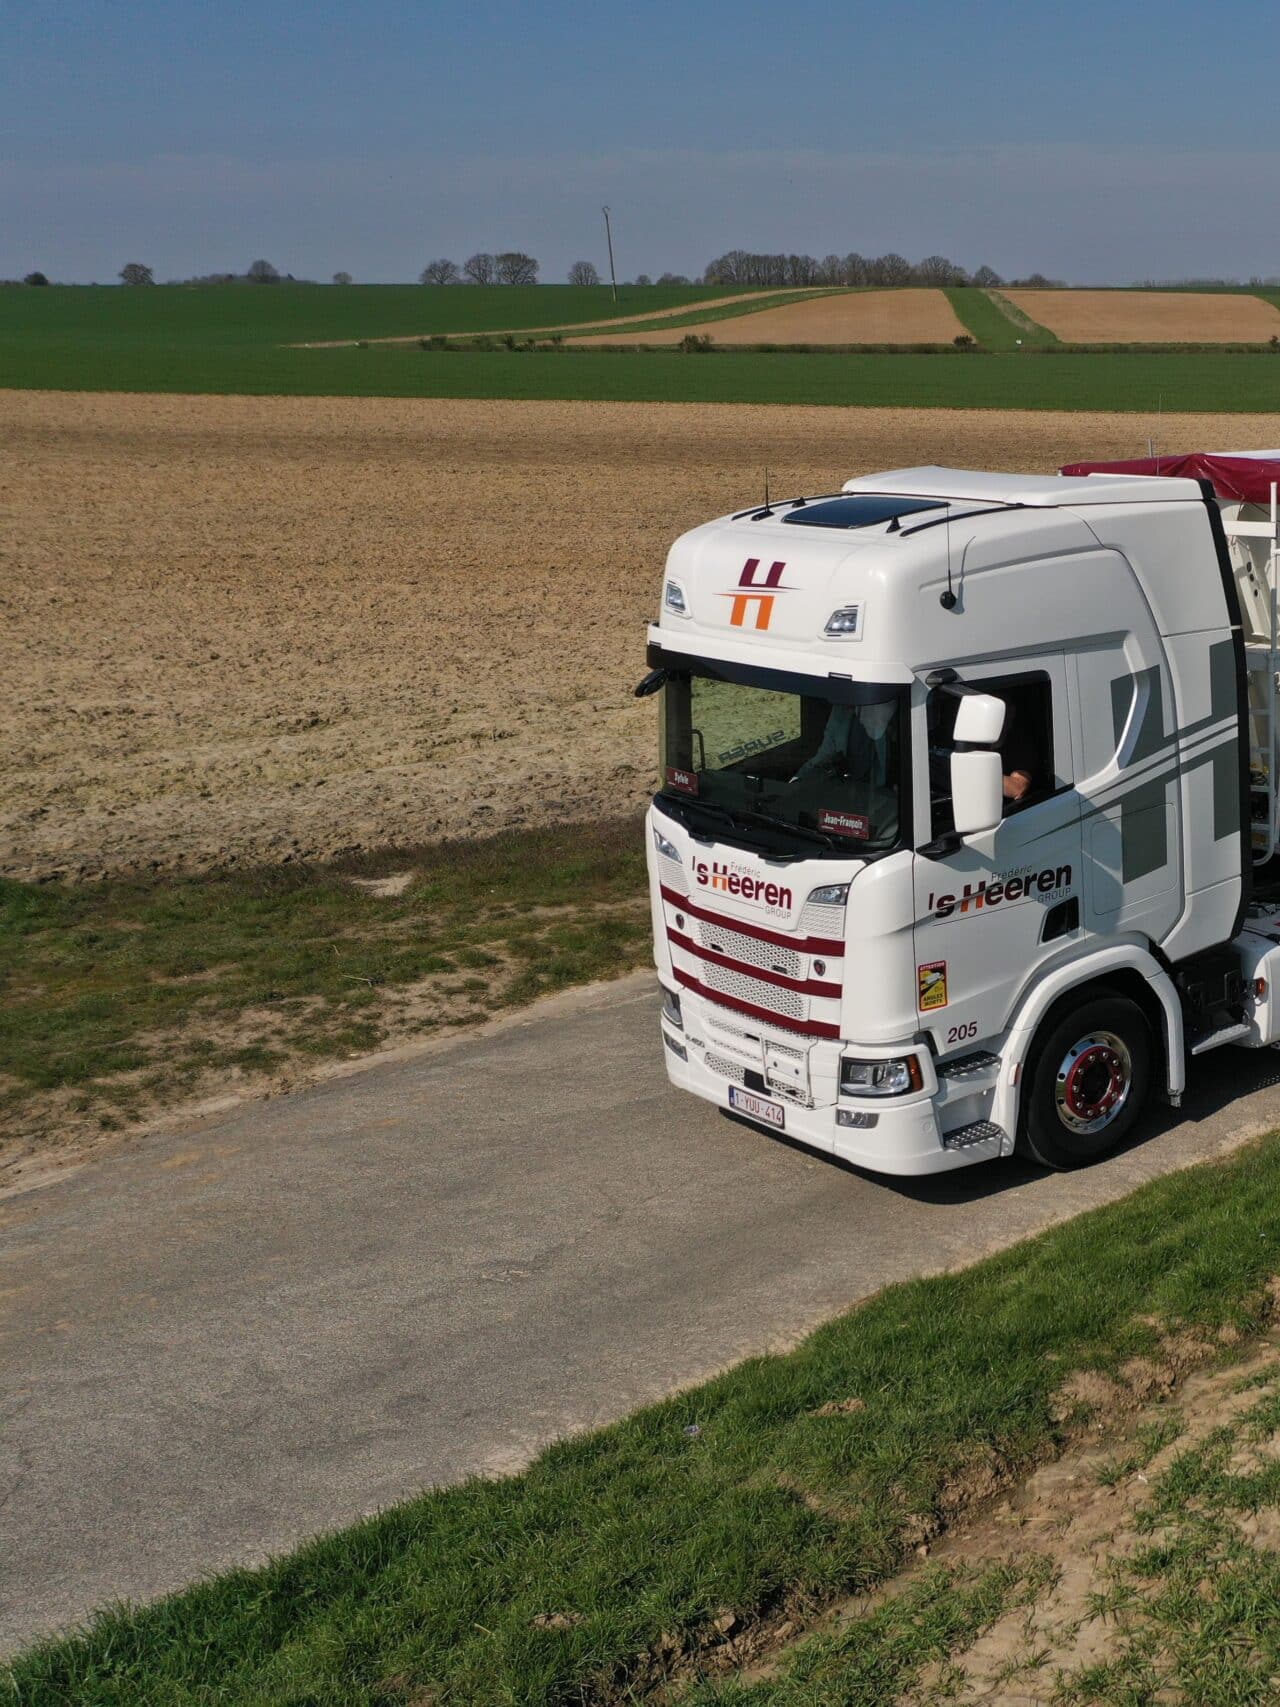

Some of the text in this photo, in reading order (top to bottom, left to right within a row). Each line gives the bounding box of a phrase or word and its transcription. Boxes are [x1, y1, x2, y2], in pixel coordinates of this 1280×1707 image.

[1037, 888, 1071, 904] GROUP
[765, 905, 792, 919] GROUP
[947, 1021, 978, 1044] 205
